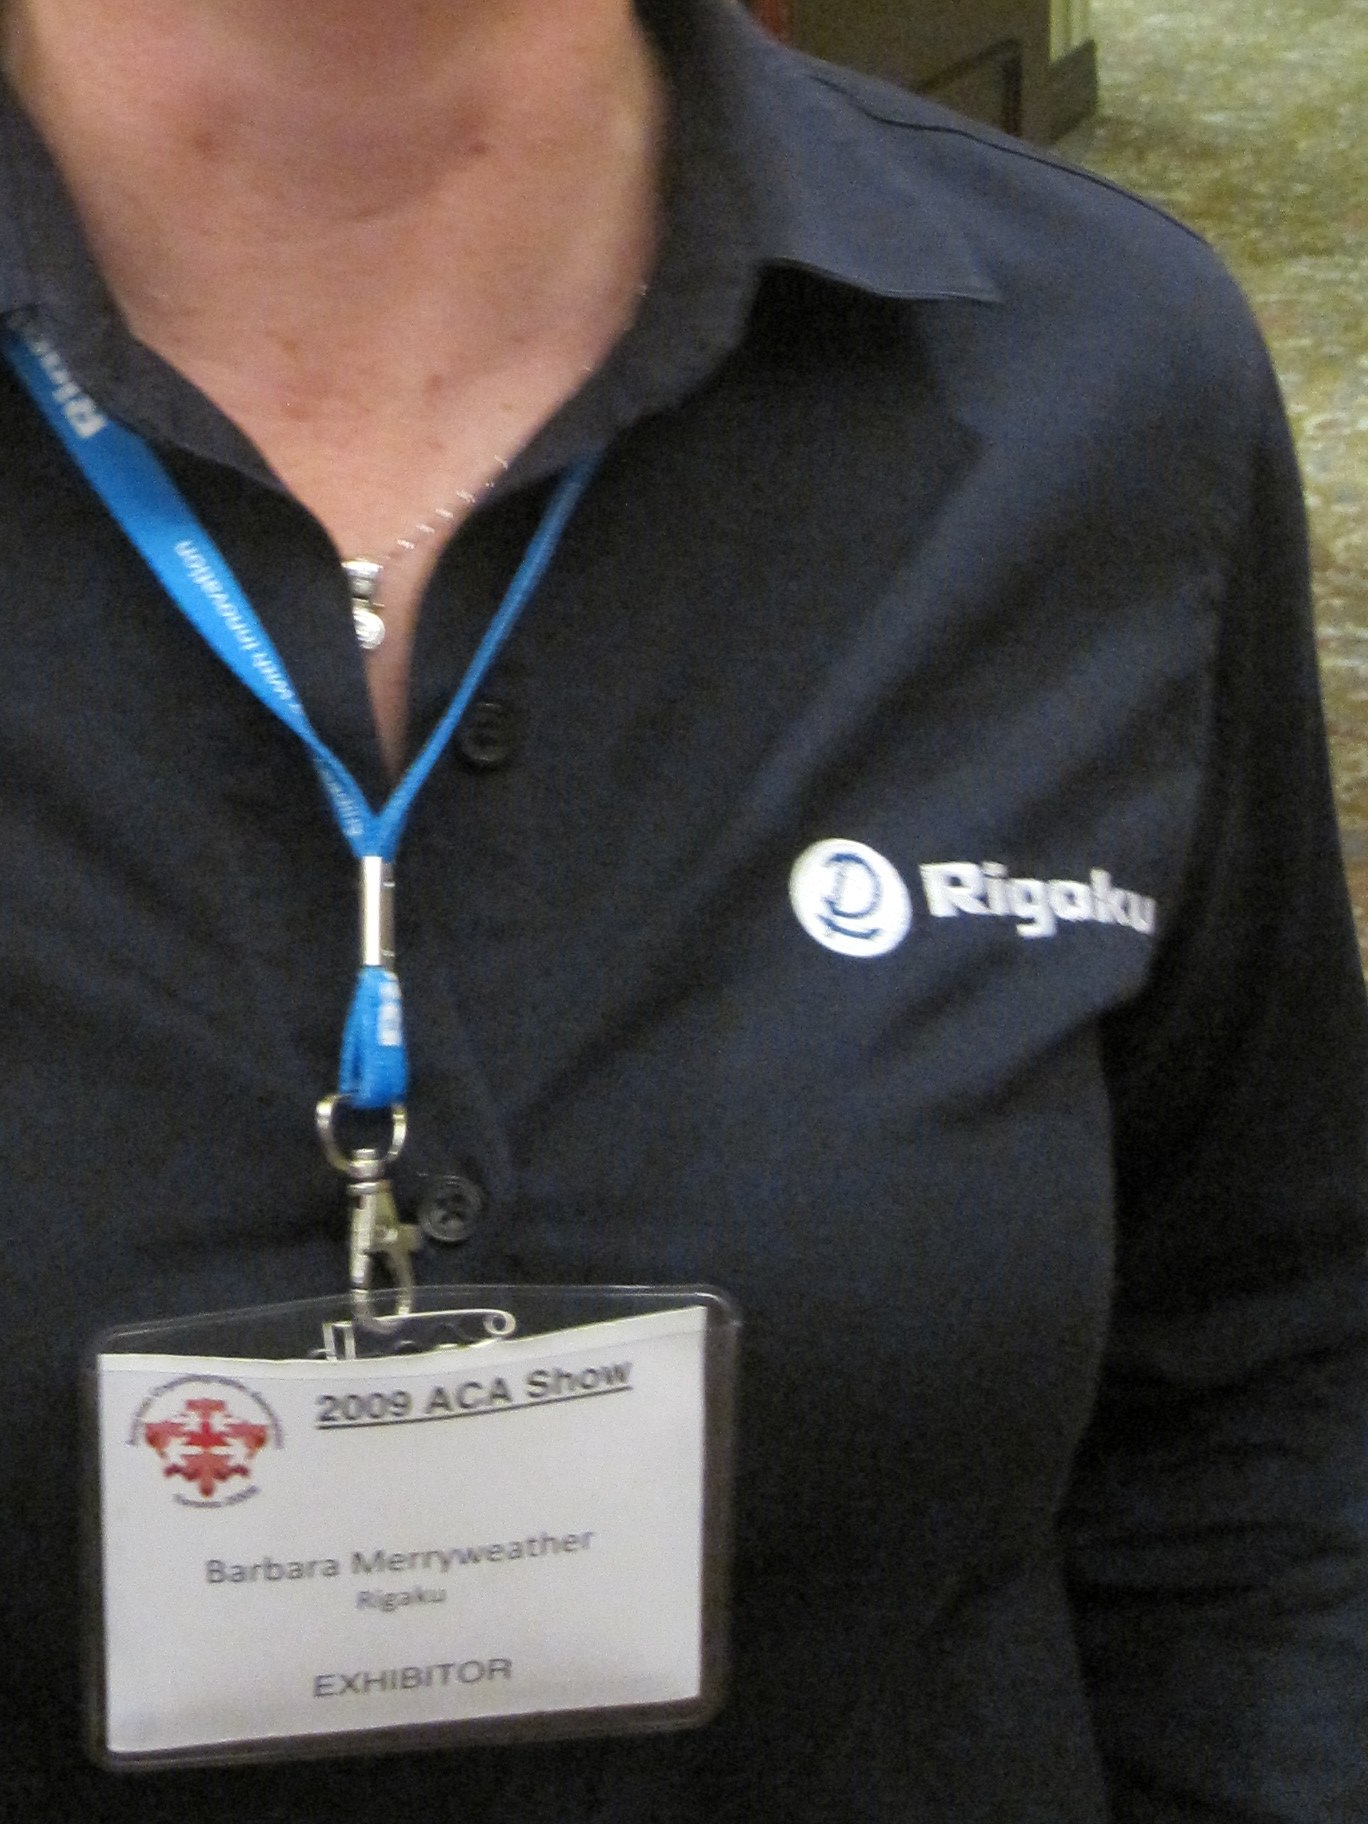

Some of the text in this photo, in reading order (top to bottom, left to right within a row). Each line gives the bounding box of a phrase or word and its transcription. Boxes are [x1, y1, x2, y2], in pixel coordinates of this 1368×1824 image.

[919, 860, 1158, 938] Rigaku
[317, 1388, 413, 1422] 2009
[425, 1377, 514, 1414] ACA
[525, 1361, 632, 1398] Show
[205, 1529, 596, 1584] Barbara Merryweather
[356, 1585, 447, 1613] Rigaku
[312, 1657, 513, 1698] EXHIBITOR
